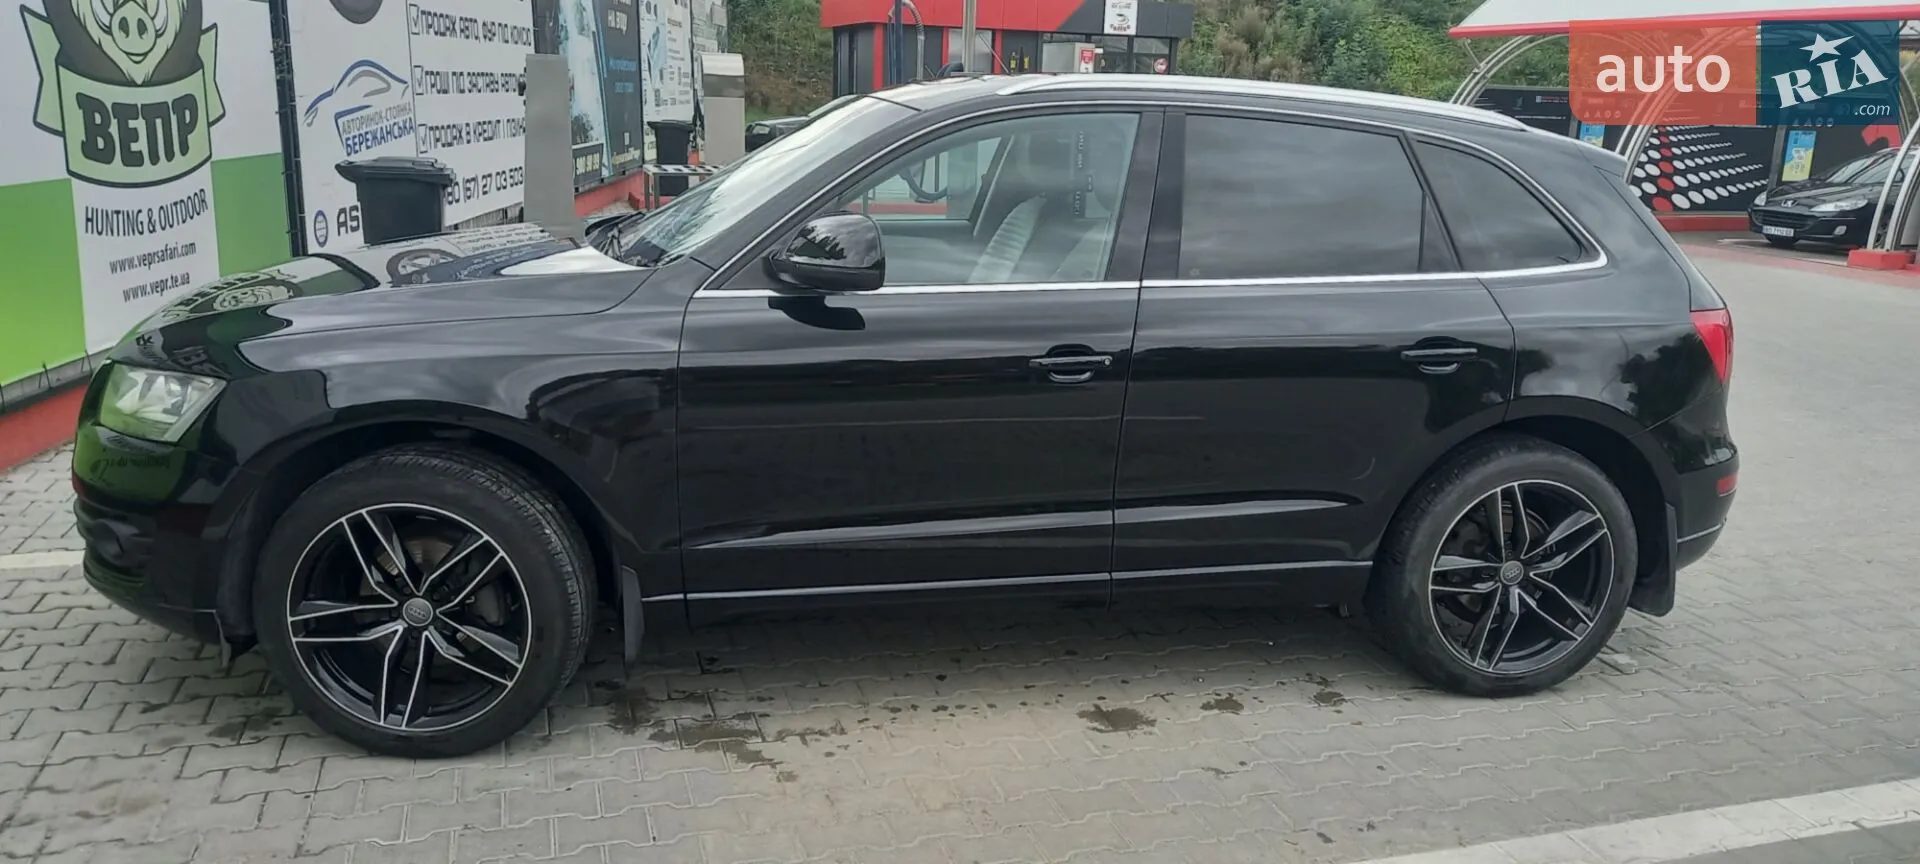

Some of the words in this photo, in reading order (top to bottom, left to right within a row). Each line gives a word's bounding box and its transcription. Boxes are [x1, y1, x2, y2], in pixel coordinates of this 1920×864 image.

[420, 10, 457, 38] ПРОДАЖ
[459, 16, 481, 44] АВТО,
[425, 71, 450, 94] ГРОШІ
[451, 71, 465, 94] ПІД
[467, 72, 499, 93] ЗАСТАВУ
[76, 92, 199, 168] ВЕПР
[342, 102, 412, 135] АВТОРИНОК-СТОЯНКА
[428, 123, 464, 150] ПРОДАЖ
[465, 122, 471, 144] В
[473, 119, 501, 142] КРЕДИТ
[345, 117, 415, 156] БЕРЕЖАНСЬКА
[445, 181, 460, 205] 80
[463, 174, 479, 203] (67)
[481, 173, 492, 195] 27
[495, 170, 507, 191] 03
[509, 166, 523, 187] 503
[85, 206, 144, 236] HUNTING
[147, 208, 156, 234] &
[159, 188, 208, 231] OUTDOOR
[109, 241, 197, 275] www.veprsafari.com
[123, 272, 190, 303] www.vepr.te.ua
